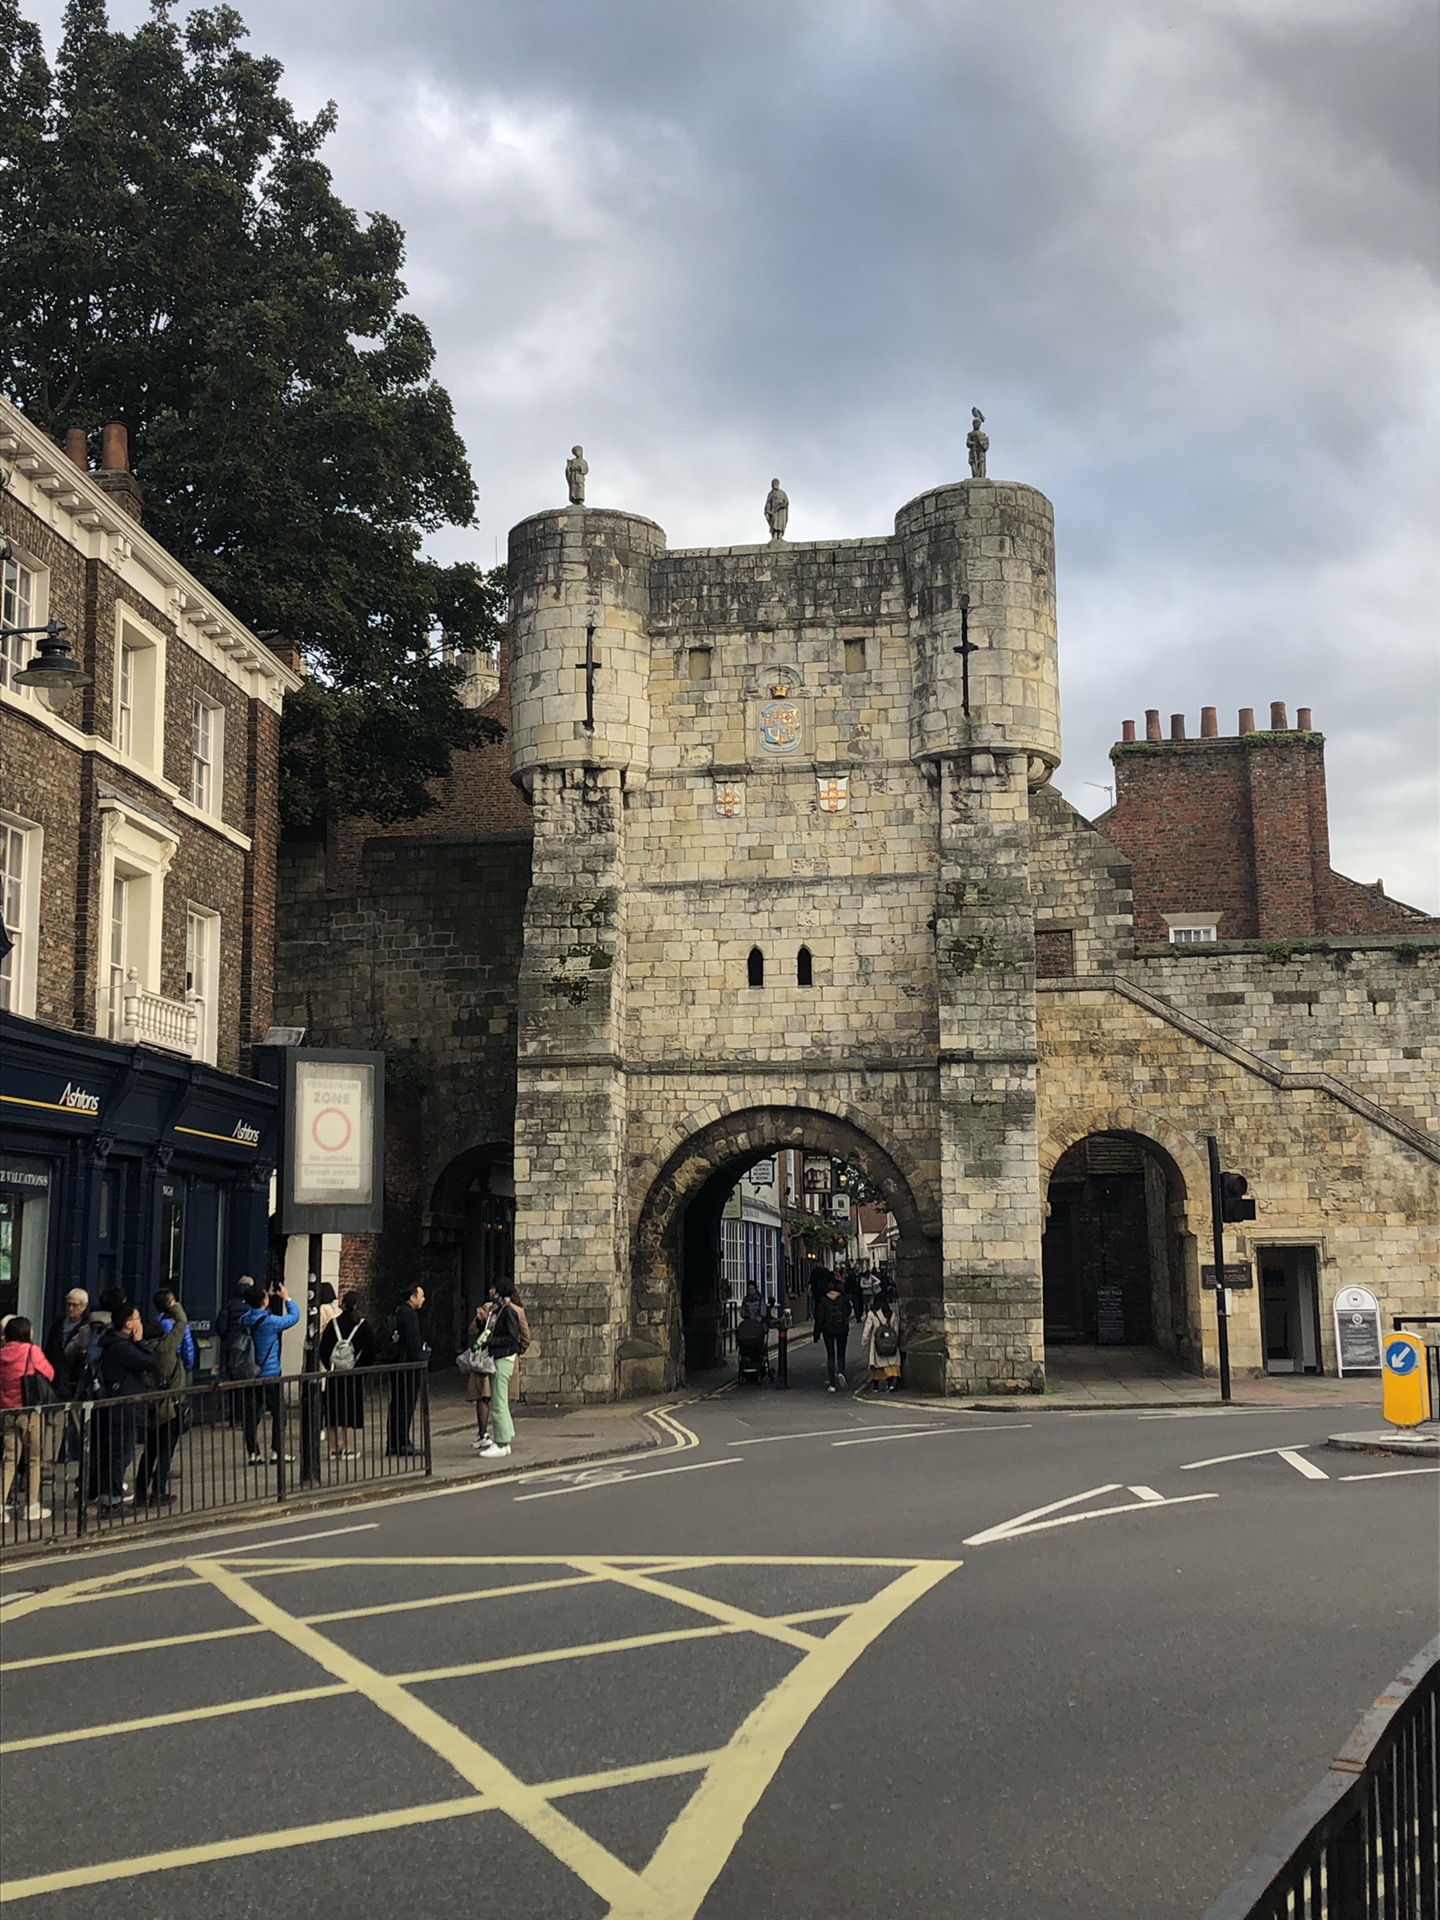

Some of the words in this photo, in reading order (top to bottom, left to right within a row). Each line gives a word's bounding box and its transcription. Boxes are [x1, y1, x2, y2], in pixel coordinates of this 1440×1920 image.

[306, 1081, 359, 1090] PEDESTRIAN
[59, 1081, 100, 1111] Ashtons
[313, 1092, 350, 1104] ZONE
[232, 1119, 260, 1143] Ashtons
